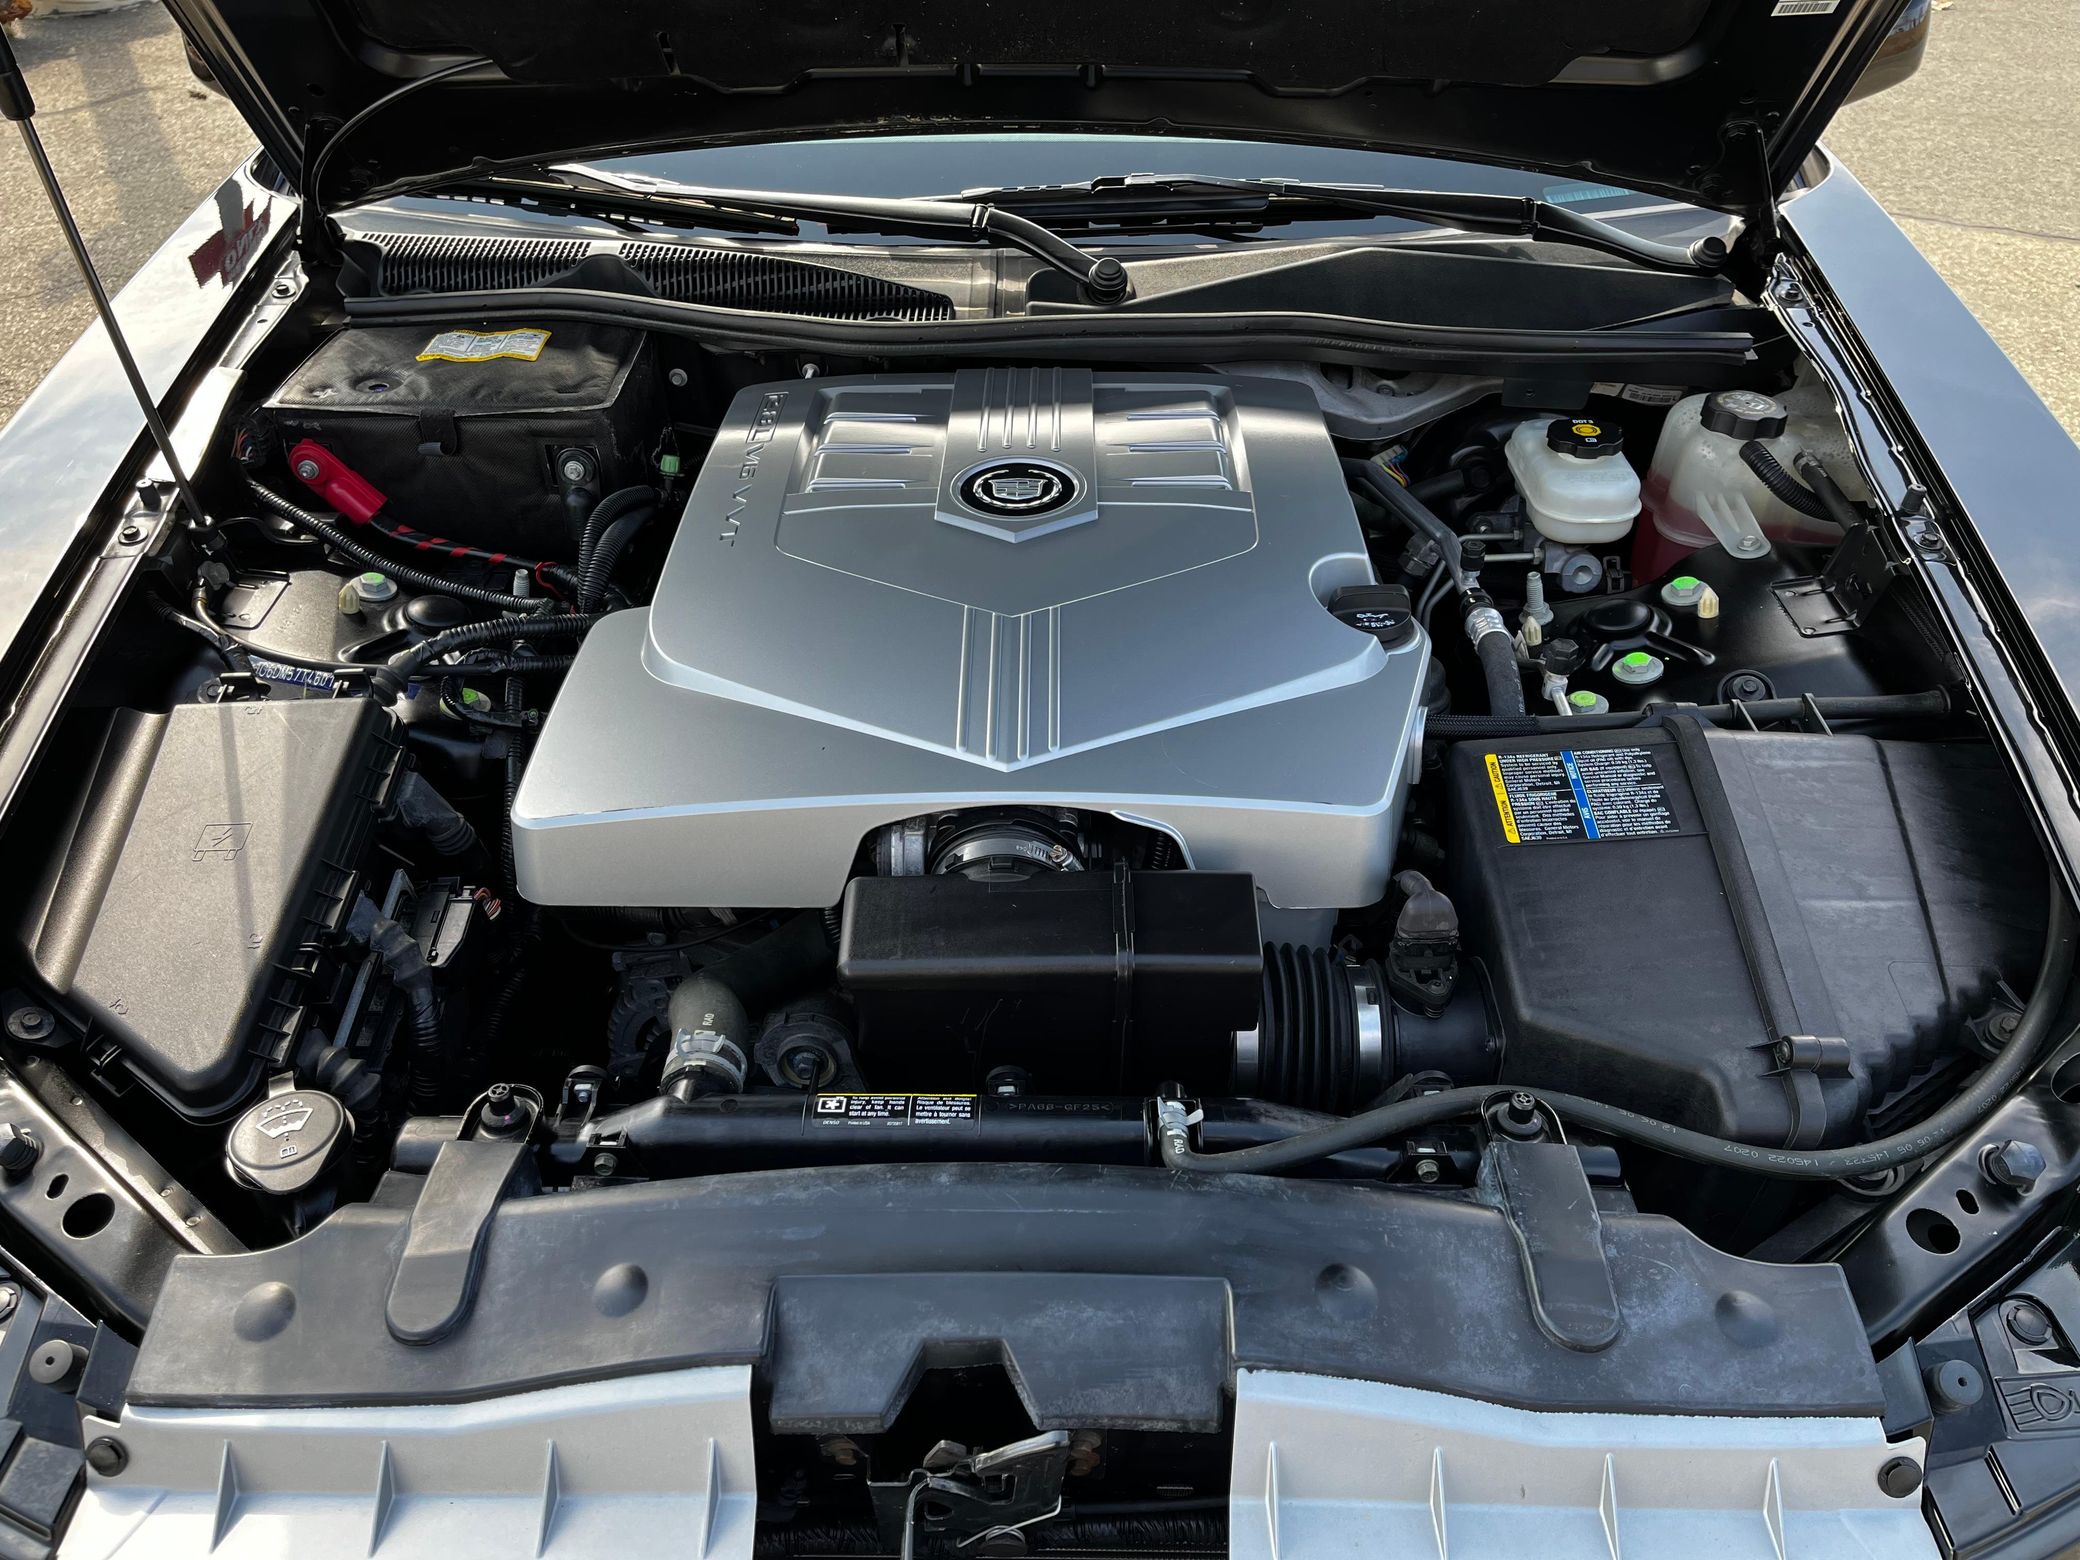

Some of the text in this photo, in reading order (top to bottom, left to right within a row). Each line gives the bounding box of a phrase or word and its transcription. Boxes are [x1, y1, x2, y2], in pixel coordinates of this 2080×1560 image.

[740, 443, 765, 480] V6
[720, 484, 752, 547] VVT
[1490, 762, 1500, 783] CAUTION
[1500, 800, 1513, 827] ATTENTION
[702, 1013, 714, 1026] RAD
[1174, 1138, 1184, 1154] RAD
[1724, 1144, 1759, 1159] 0207
